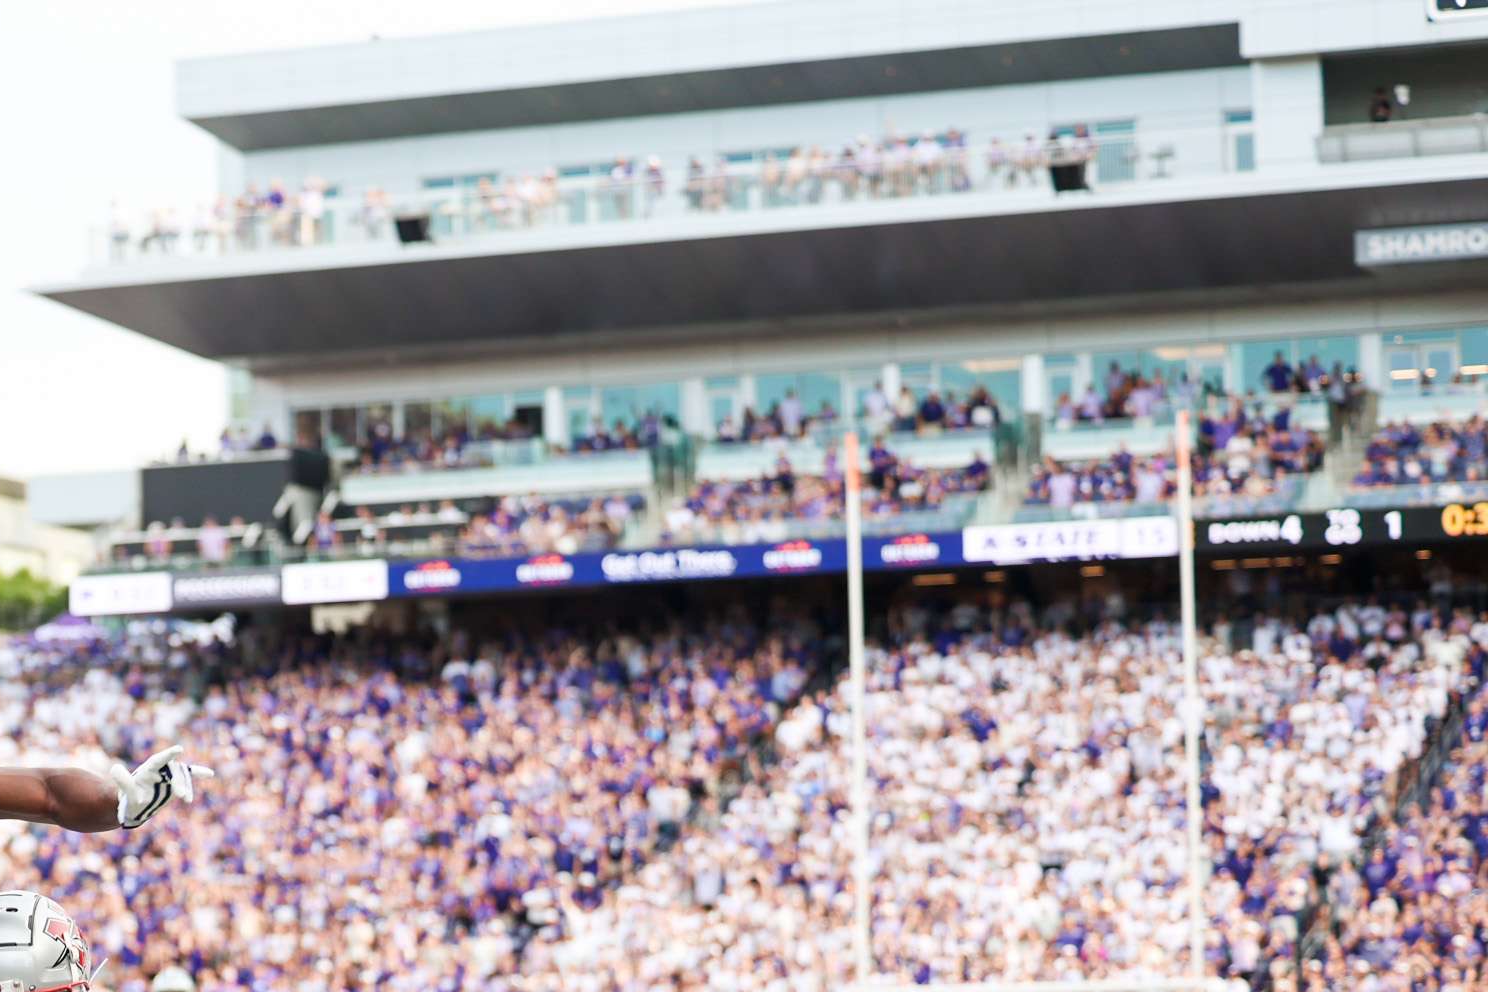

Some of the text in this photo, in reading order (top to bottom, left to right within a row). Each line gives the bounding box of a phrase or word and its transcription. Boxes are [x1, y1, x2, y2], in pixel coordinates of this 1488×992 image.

[1209, 515, 1303, 545] DOWN 4
[1384, 510, 1402, 540] 1
[174, 573, 280, 600] POSSESSION
